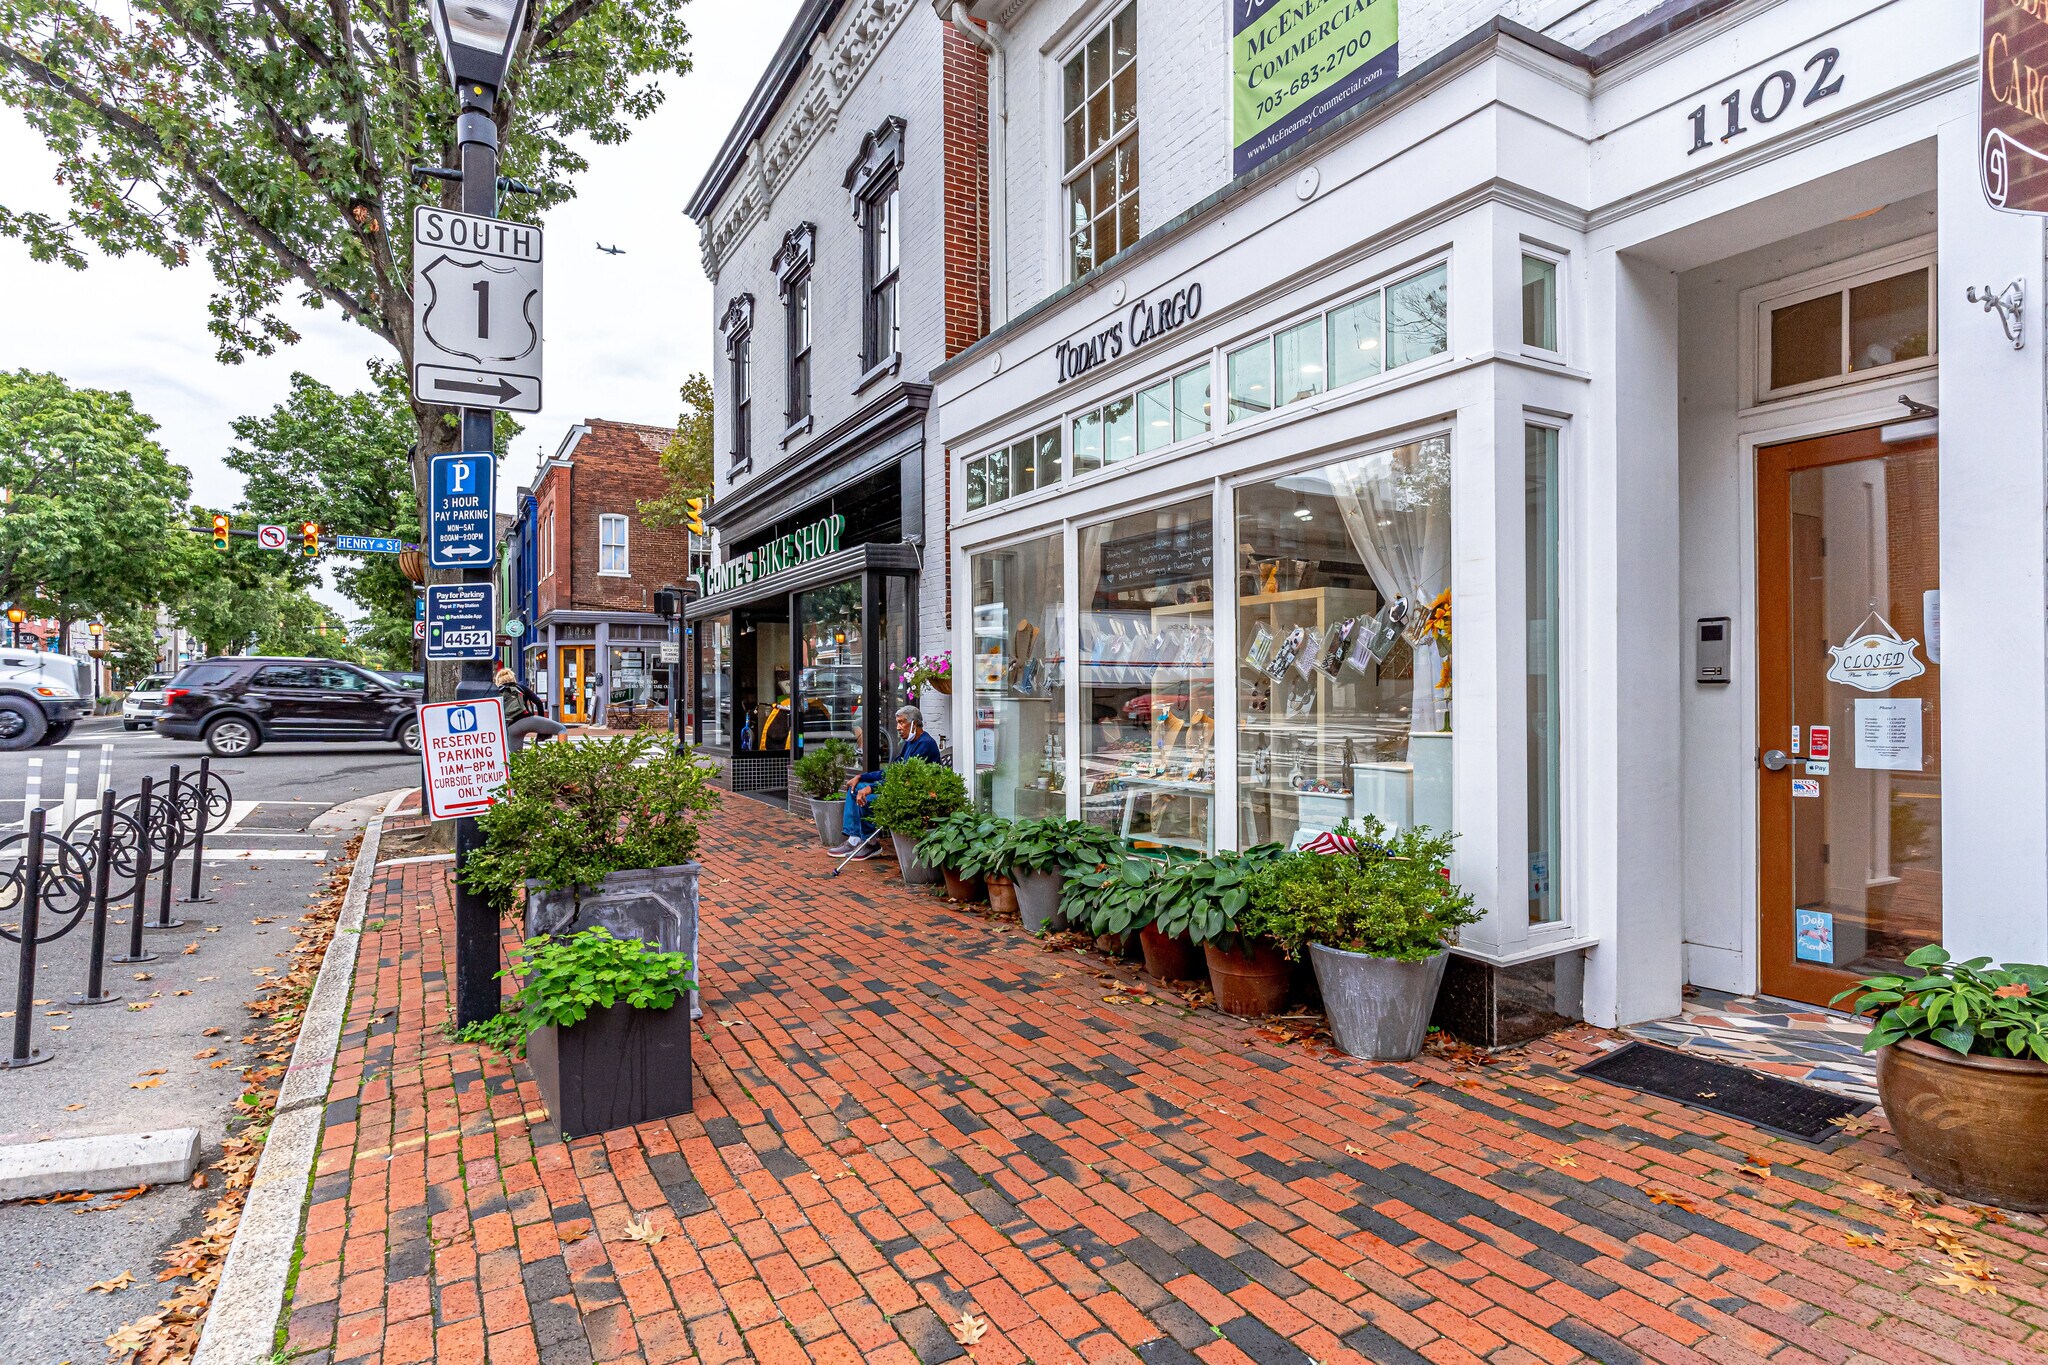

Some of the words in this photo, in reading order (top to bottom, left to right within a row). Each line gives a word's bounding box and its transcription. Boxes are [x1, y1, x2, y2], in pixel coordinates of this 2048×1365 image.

[1256, 29, 1371, 120] 703-683-2700
[1687, 47, 1844, 156] 1102
[1247, 67, 1383, 159] www.McEnearneyCommercial.com
[426, 213, 530, 257] SOUTH
[472, 280, 490, 339] 1
[1055, 321, 1123, 383] TODAY'S
[1128, 282, 1202, 347] CARGO
[452, 463, 470, 492] P
[443, 498, 449, 509] 3
[451, 496, 479, 508] HOUR
[435, 511, 451, 521] PAY
[453, 509, 488, 520] PARKING
[338, 537, 376, 549] HENRY
[706, 551, 755, 596] CONTE'S
[757, 534, 792, 579] BIKE
[794, 513, 843, 566] SHOP
[436, 592, 449, 600] Pay
[460, 591, 485, 599] Parking
[445, 632, 488, 646] 44521
[1843, 652, 1905, 669] CLOSED
[432, 732, 497, 749] RESERVED
[438, 746, 493, 763] PARKING
[1814, 764, 1827, 772] Pay
[434, 774, 473, 789] CURBSIDE
[476, 771, 504, 784] PICKUP
[458, 786, 483, 798] ONLY
[1800, 914, 1825, 929] Dog
[1797, 936, 1832, 952] Friendly
